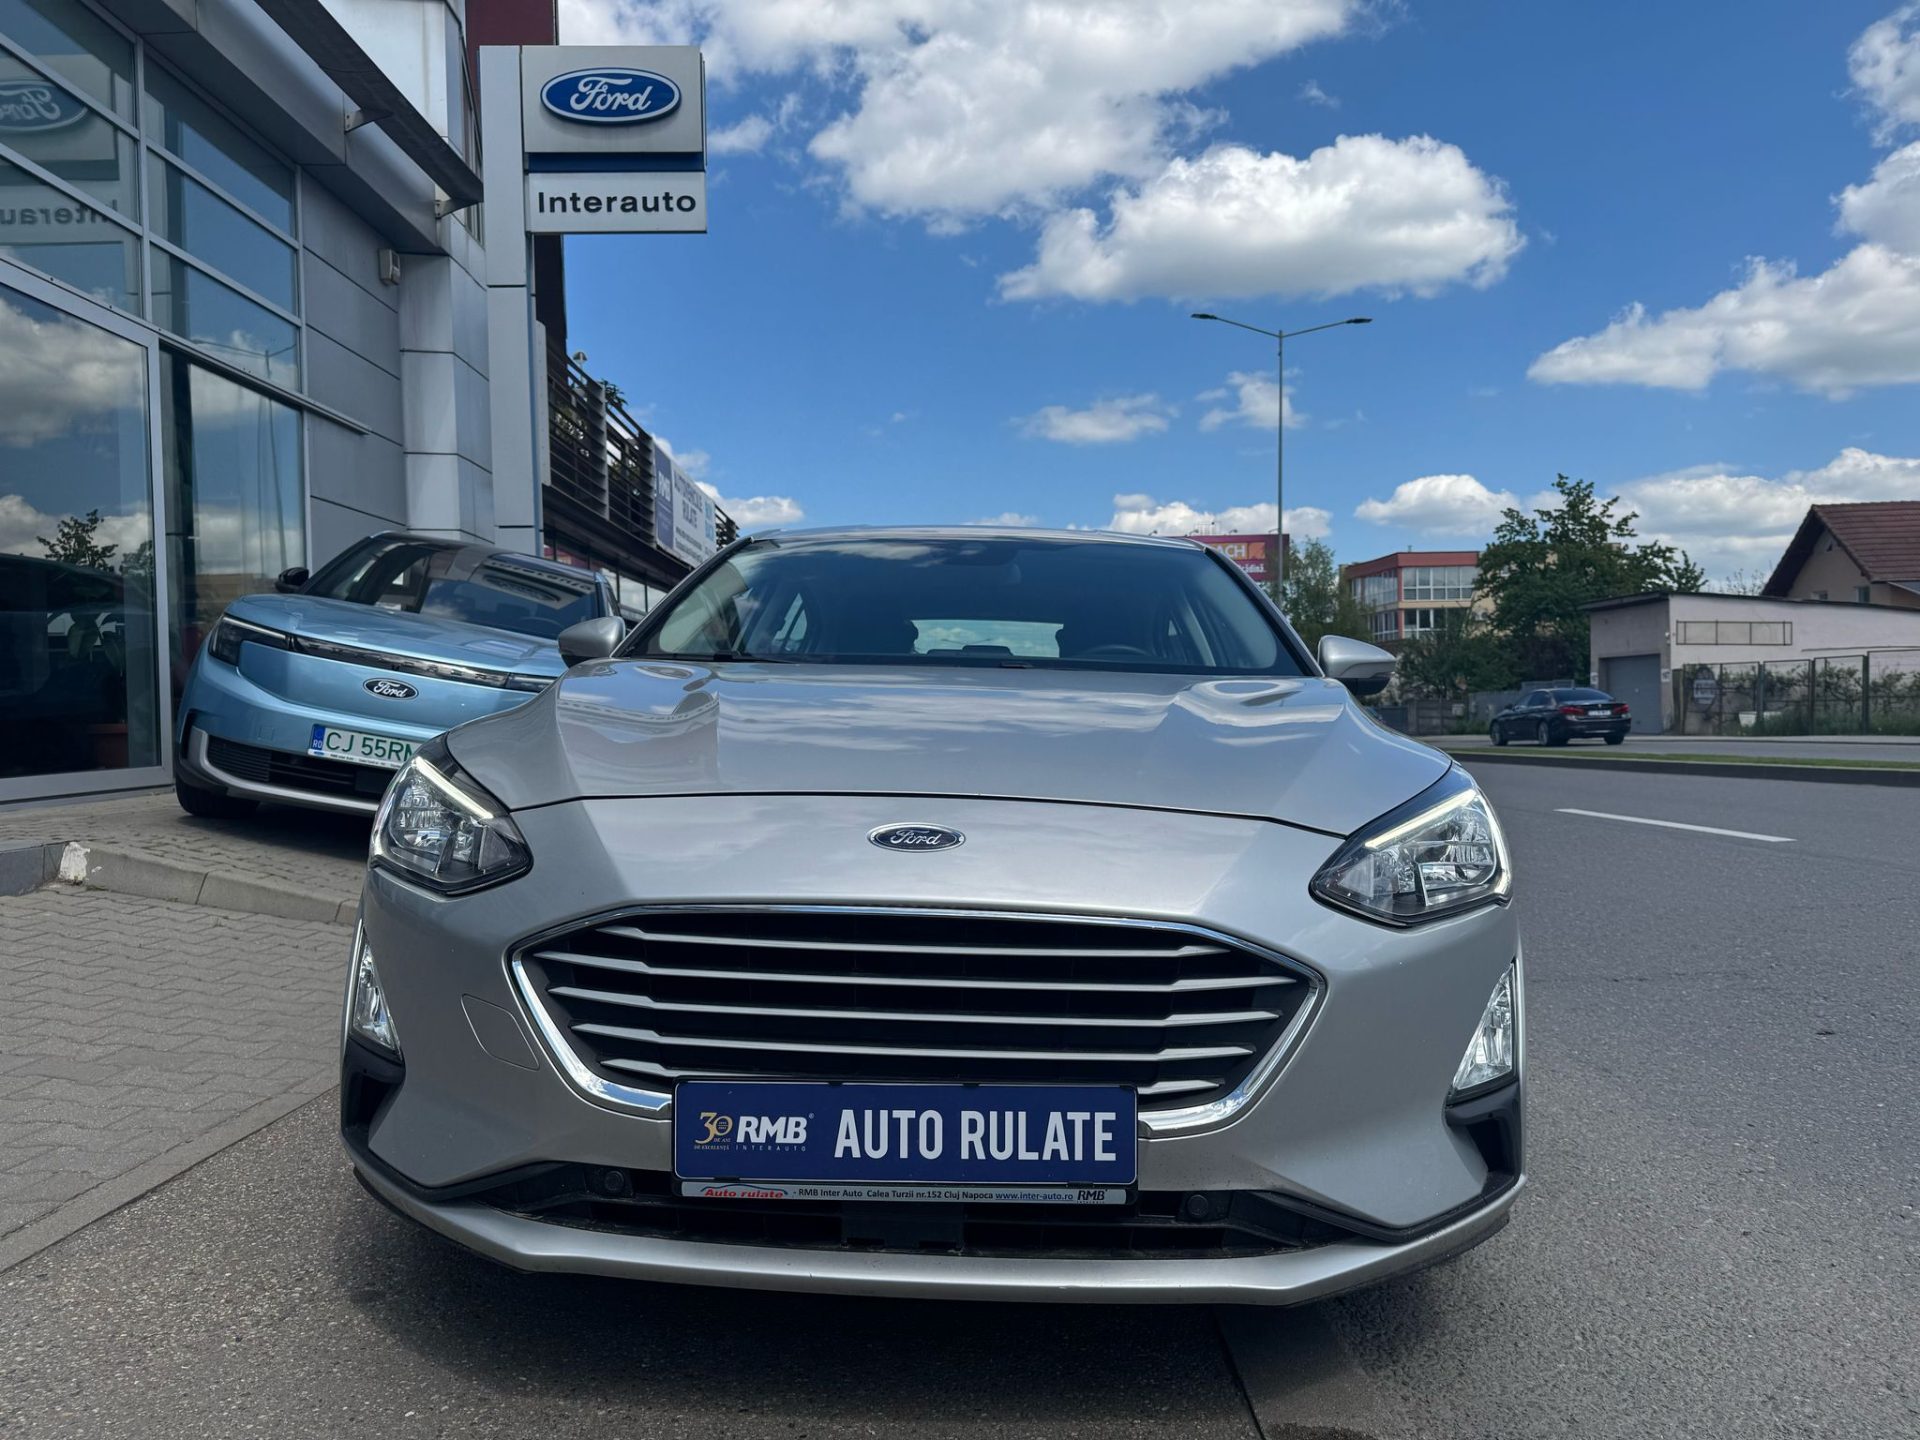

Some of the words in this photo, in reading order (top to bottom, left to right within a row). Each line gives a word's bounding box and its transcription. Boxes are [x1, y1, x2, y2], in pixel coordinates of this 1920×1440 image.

[569, 76, 653, 111] Ford
[538, 191, 697, 214] Interauto
[1214, 544, 1246, 558] ACH
[373, 680, 408, 698] Ford
[312, 739, 323, 748] RO
[326, 731, 355, 752] CJ
[890, 829, 942, 845] Ford
[736, 1115, 808, 1144] RMB
[834, 1109, 943, 1160] AUTO
[960, 1110, 1117, 1161] RULATE
[735, 1144, 806, 1152] INTERAUTO
[704, 1188, 737, 1198] Auto
[798, 1188, 819, 1197] RMB
[820, 1188, 840, 1197] Inter
[842, 1189, 863, 1198] Auto
[866, 1189, 888, 1198] Calea
[890, 1189, 914, 1199] Turzii
[916, 1190, 942, 1199] nr.152
[944, 1190, 960, 1200] Cluj
[962, 1191, 994, 1201] Napoca
[995, 1192, 1074, 1202] www.inter-auto.ro
[1076, 1190, 1106, 1201] RMB
